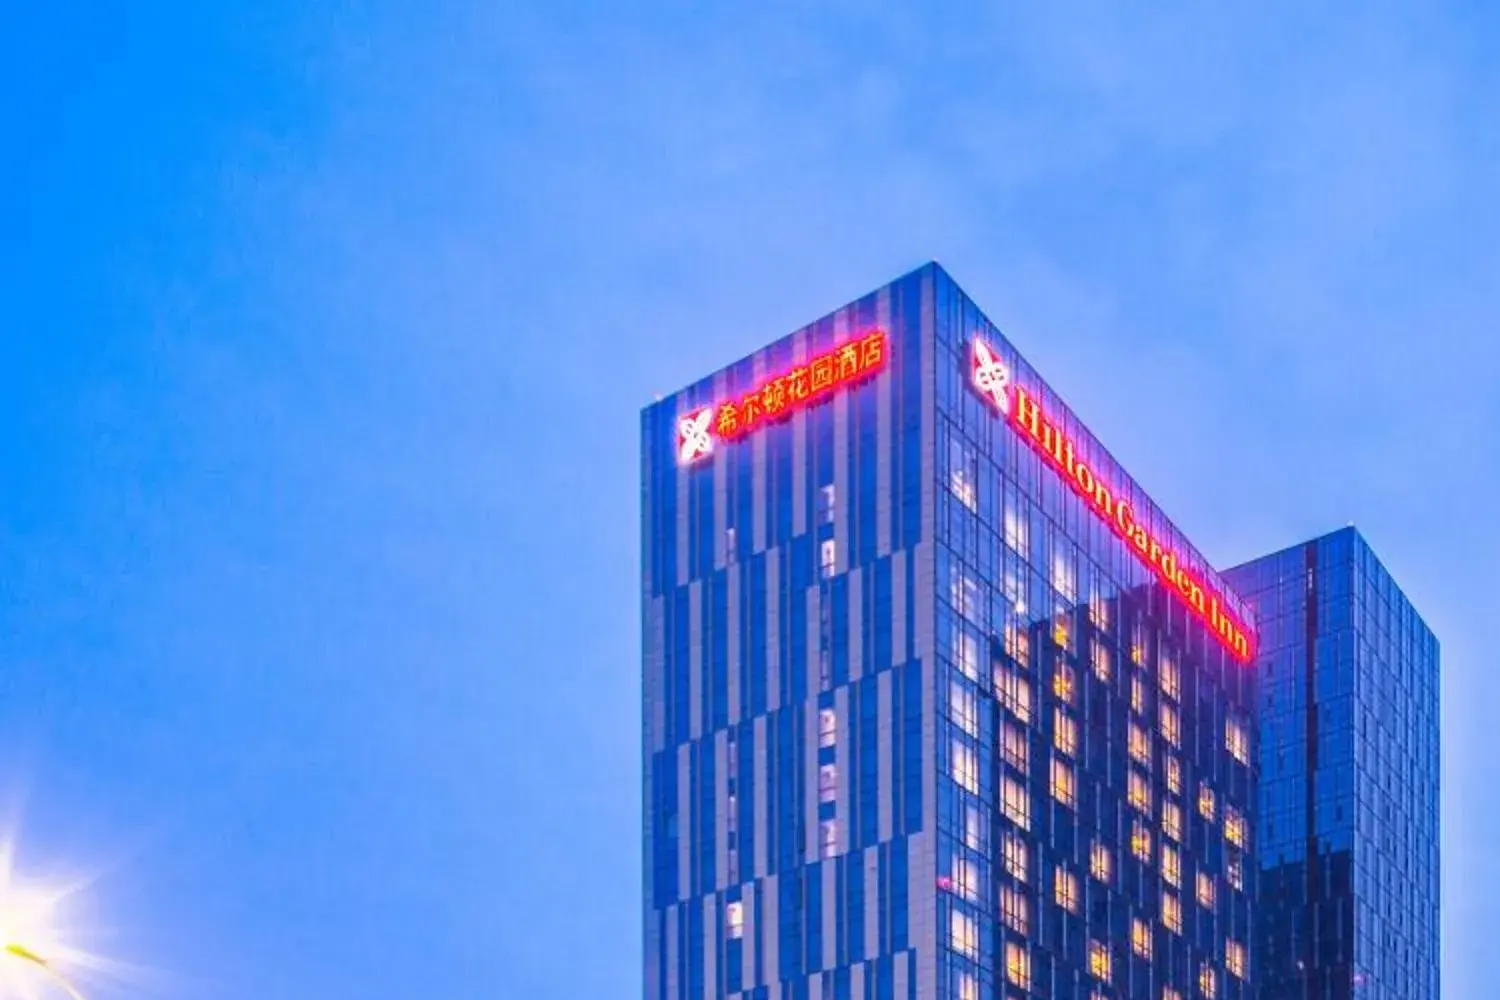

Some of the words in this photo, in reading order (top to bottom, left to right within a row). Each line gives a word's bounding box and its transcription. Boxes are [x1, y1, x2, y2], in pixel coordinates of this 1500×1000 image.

[716, 330, 885, 434] 希尔顿花园酒店
[1013, 383, 1114, 516] Hilton
[1115, 500, 1207, 614] Garden
[1209, 592, 1250, 658] Inn
